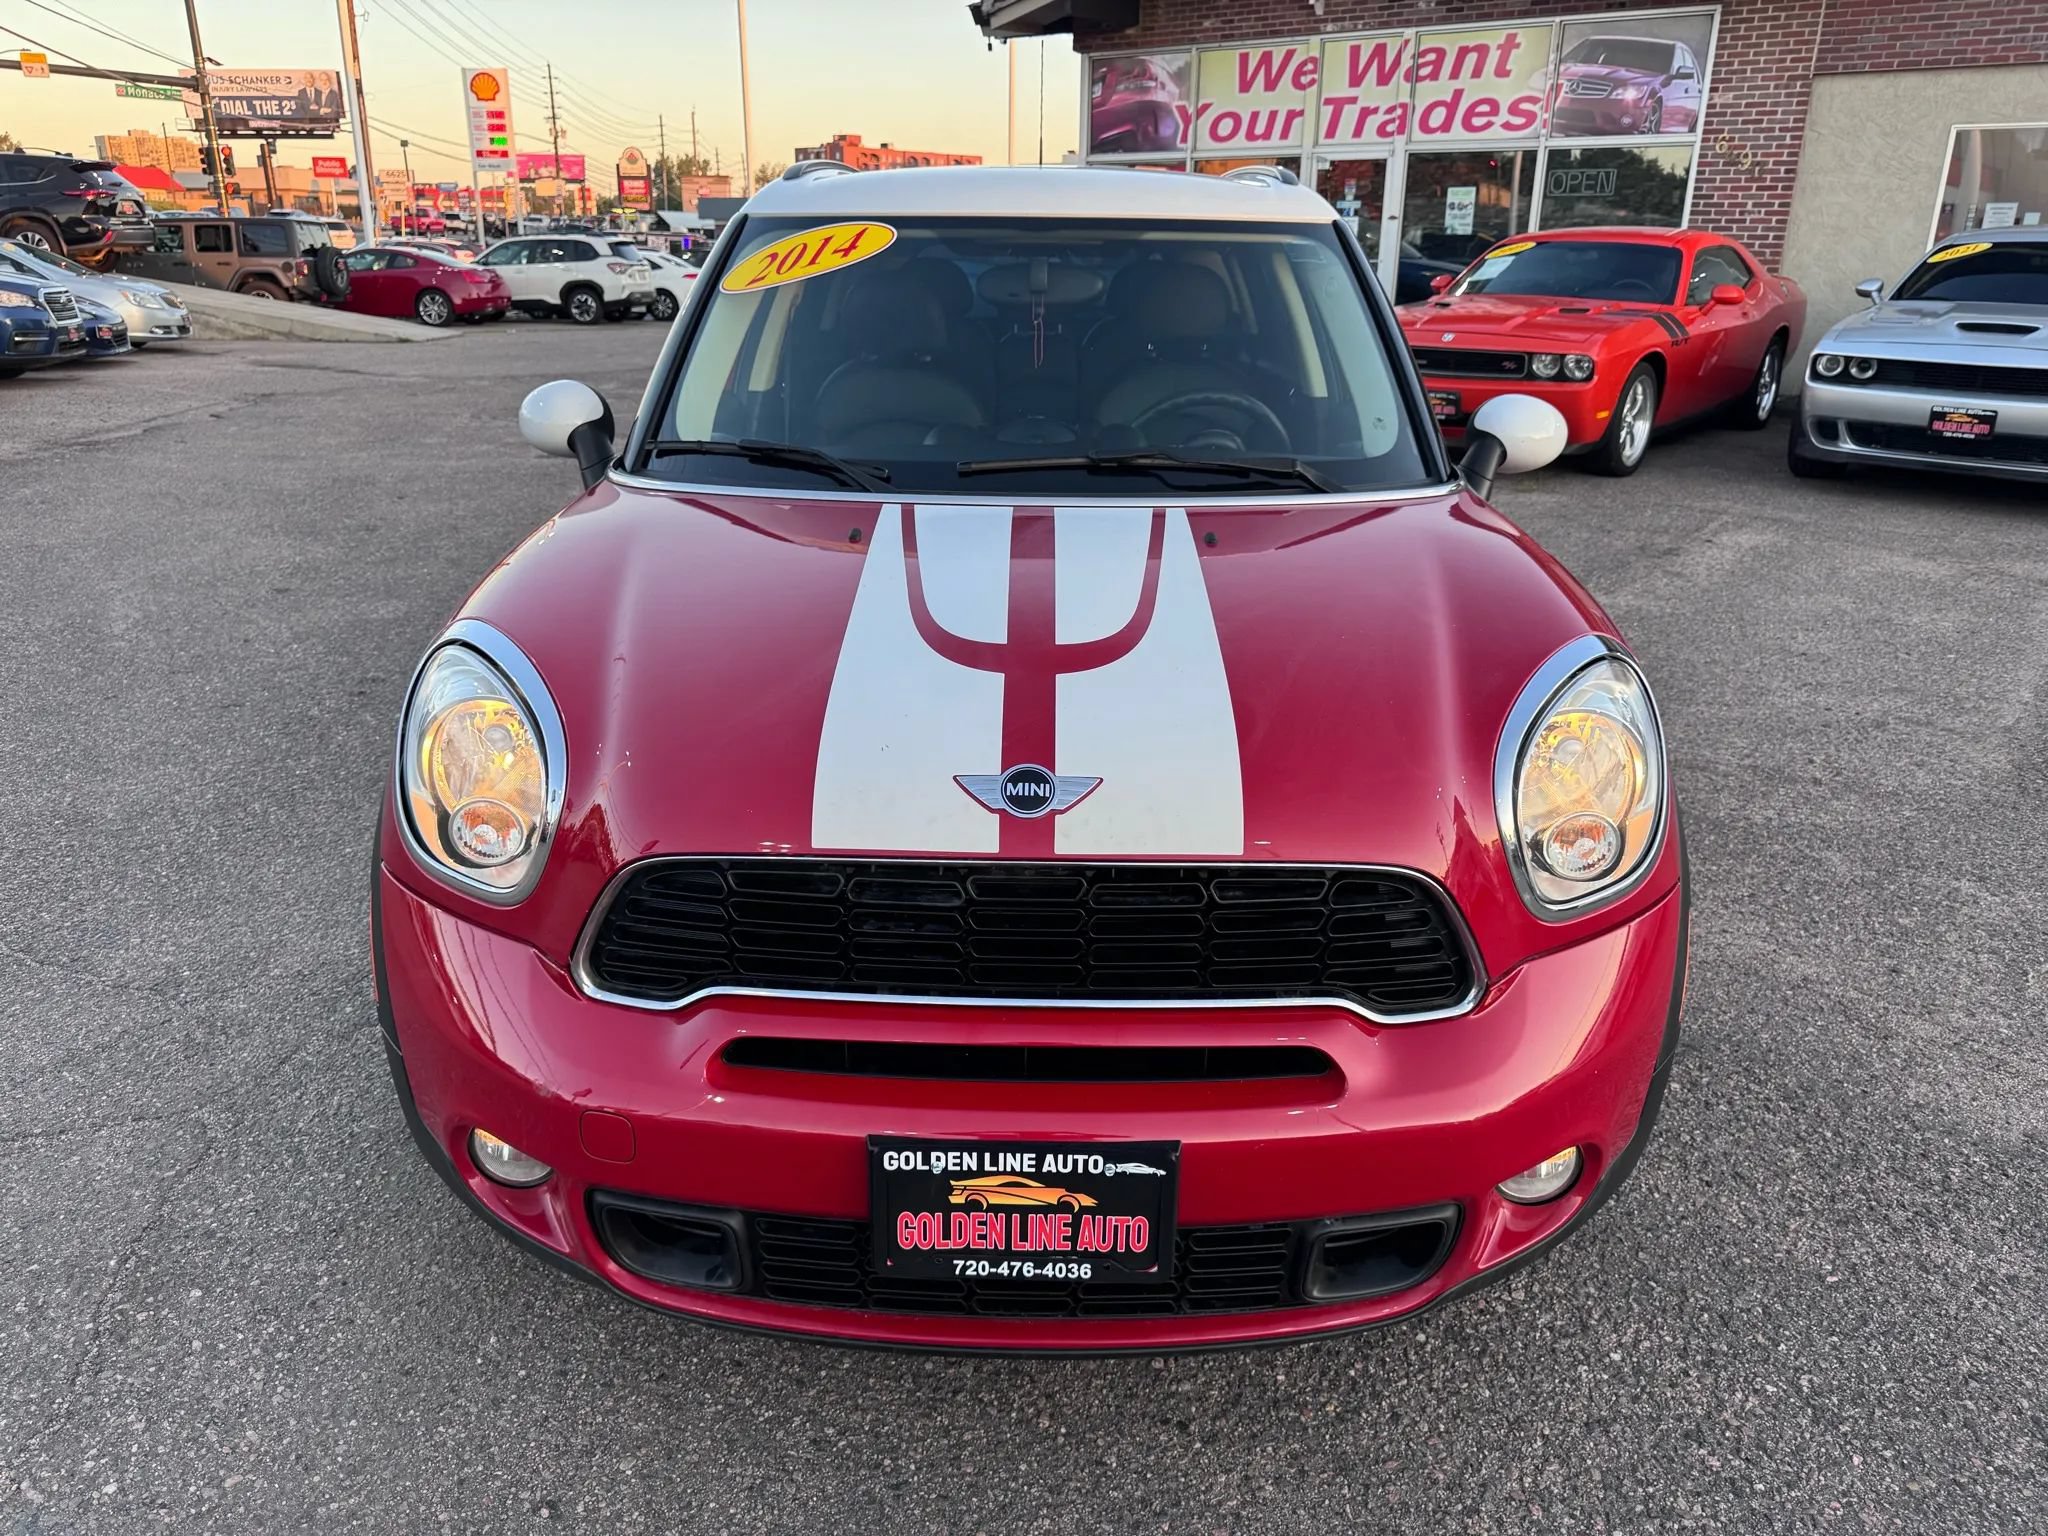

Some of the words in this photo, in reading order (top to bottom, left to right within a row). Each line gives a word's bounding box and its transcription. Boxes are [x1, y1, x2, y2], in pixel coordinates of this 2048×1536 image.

[1238, 48, 1319, 93] We
[1348, 32, 1521, 88] Want
[228, 75, 281, 85] SCHANKER
[220, 100, 252, 115] DIAL
[253, 100, 281, 115] THE
[1175, 103, 1304, 144] Your
[1322, 83, 1563, 139] Trades!
[1550, 171, 1614, 194] OPEN
[745, 226, 870, 287] 2014
[1006, 782, 1050, 797] MINI
[883, 1151, 978, 1173] GOLDEN
[984, 1152, 1036, 1173] LINE
[1042, 1154, 1103, 1174] AUTO
[897, 1211, 1005, 1249] GOLDEN
[1011, 1213, 1071, 1251] LINE
[1077, 1214, 1149, 1252] AUTO
[953, 1260, 1092, 1279] 720-476-4036
